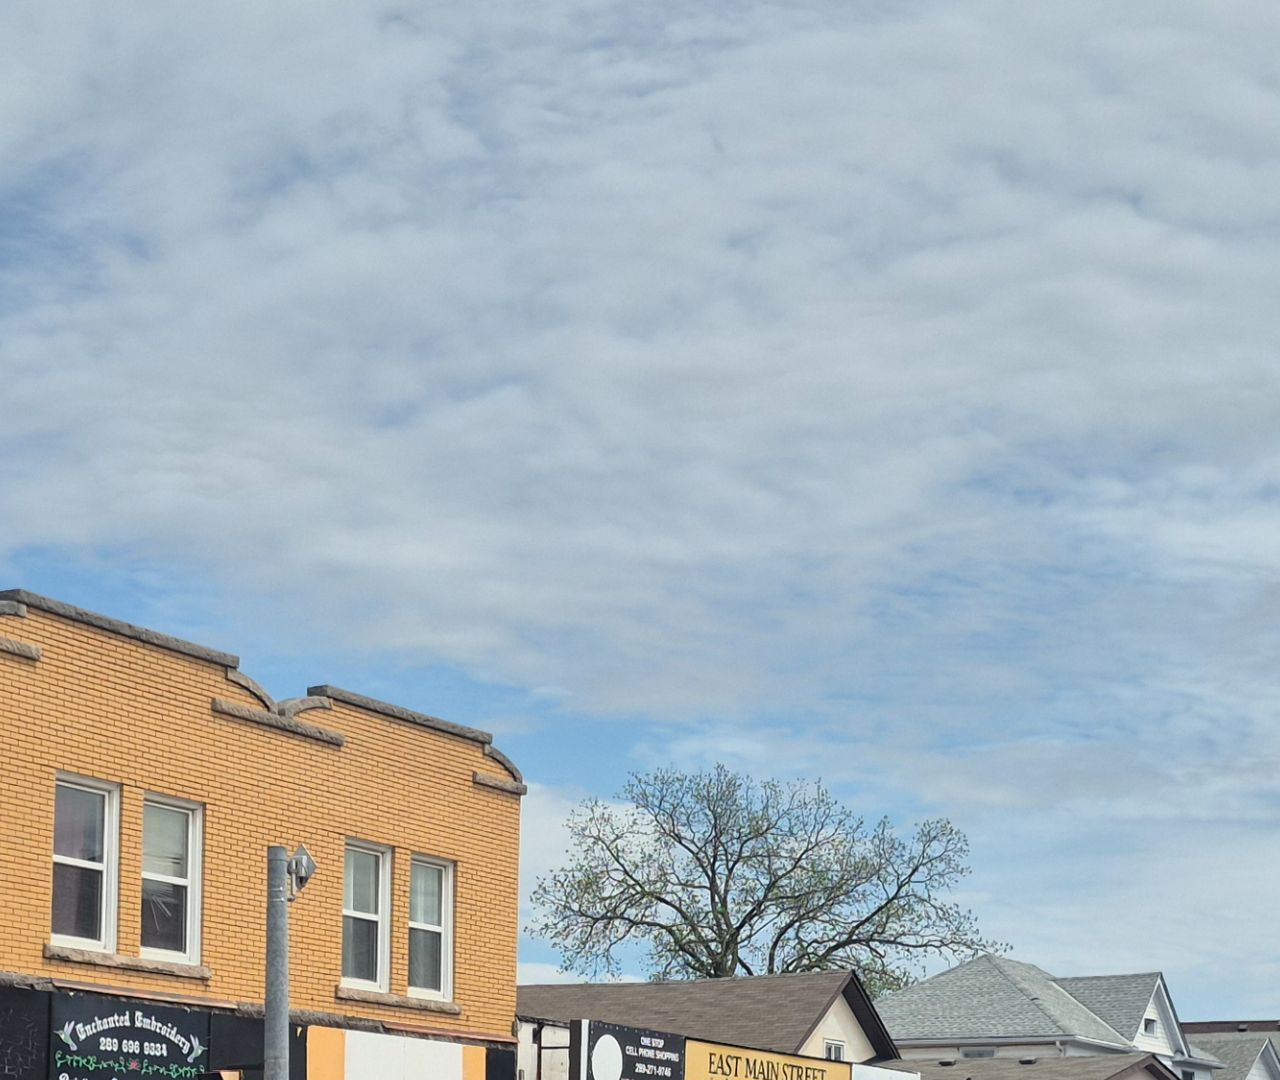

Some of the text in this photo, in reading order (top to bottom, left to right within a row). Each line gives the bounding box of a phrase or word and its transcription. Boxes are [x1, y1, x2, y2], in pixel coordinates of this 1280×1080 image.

[75, 1010, 191, 1054] Enchanted Embroidery
[640, 1036, 664, 1048] ONE STOP
[99, 1037, 167, 1057] 289 696 9334
[625, 1045, 679, 1062] CELL PHONE SHOPPING
[708, 1052, 742, 1077] EAST
